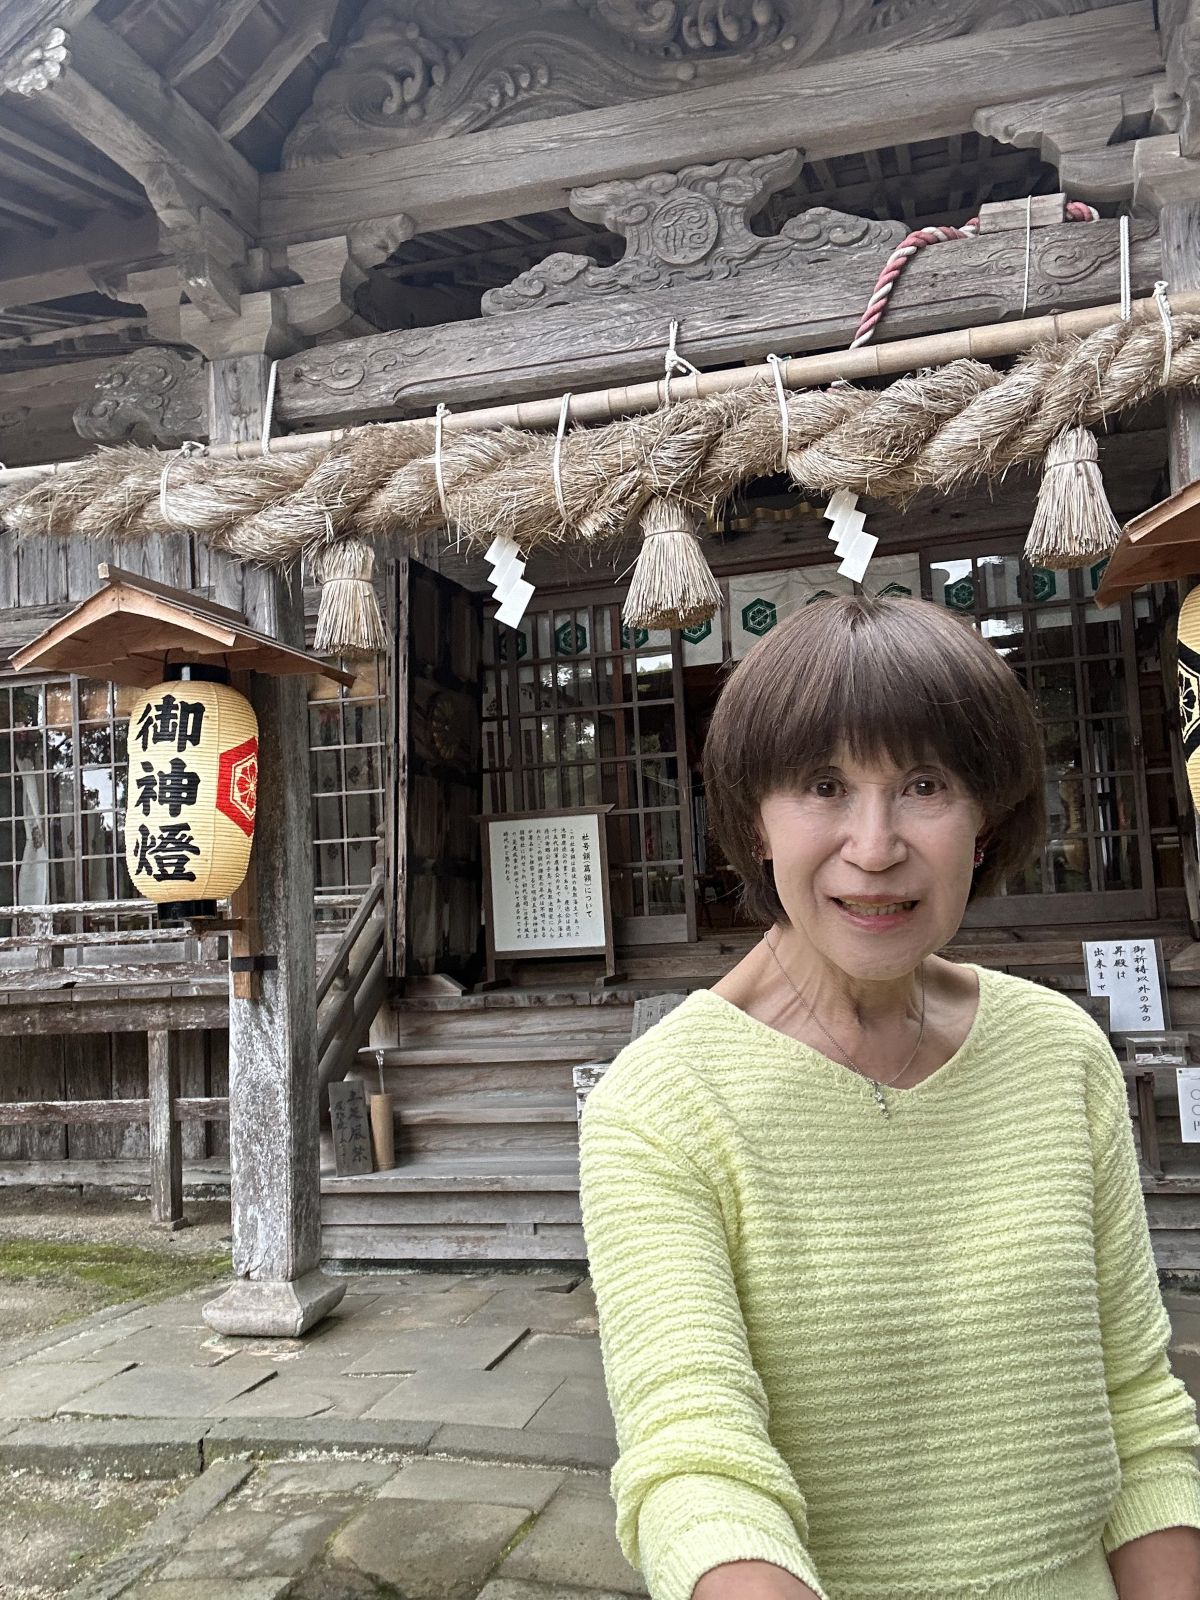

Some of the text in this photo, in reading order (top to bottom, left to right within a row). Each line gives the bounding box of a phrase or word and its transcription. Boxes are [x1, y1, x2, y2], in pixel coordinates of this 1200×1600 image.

[134, 694, 206, 882] 御神燈
[1112, 946, 1128, 979] 昇殿は
